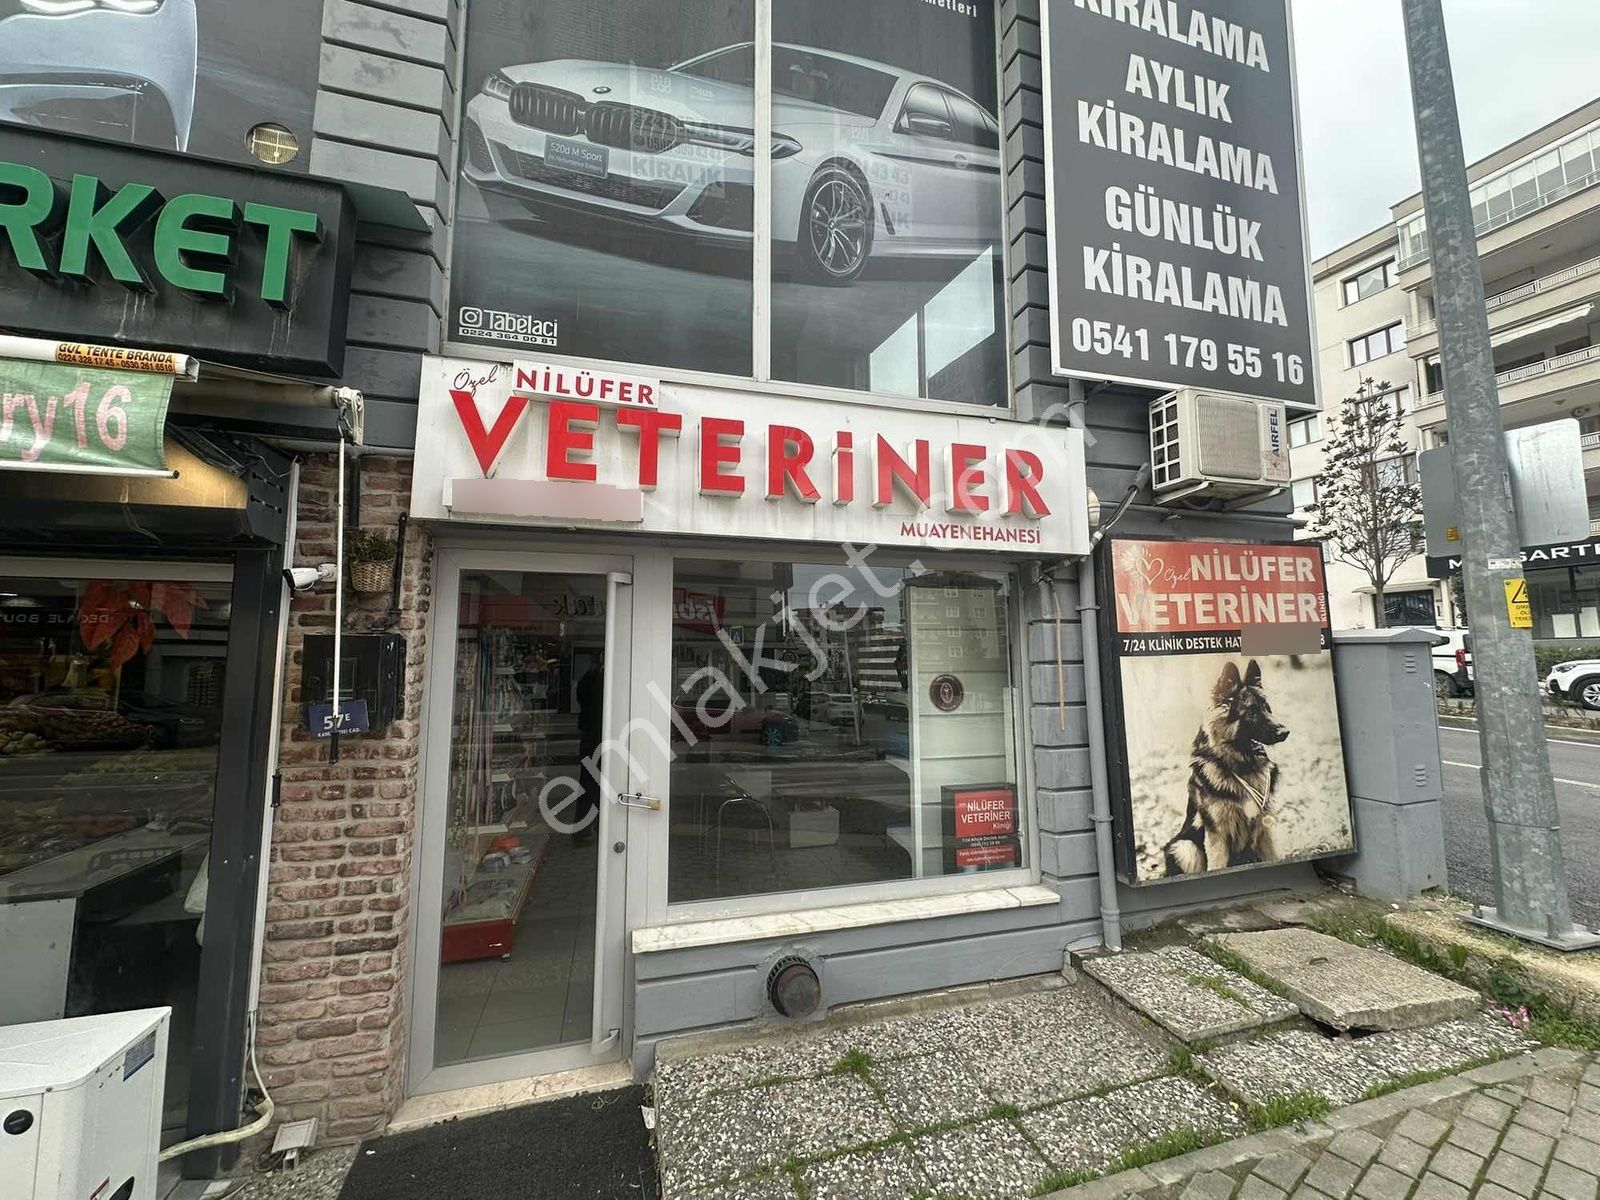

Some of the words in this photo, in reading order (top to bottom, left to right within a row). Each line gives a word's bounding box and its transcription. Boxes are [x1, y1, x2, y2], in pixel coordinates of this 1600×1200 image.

[1125, 53, 1232, 124] AYLIK
[572, 147, 579, 156] M
[1077, 99, 1279, 195] KİRALAMA
[1104, 184, 1264, 262] GÜNLÜK
[1083, 242, 1288, 327] KİRALAMA
[462, 329, 493, 338] 0224
[57, 353, 76, 363] 0224
[86, 345, 123, 359] TENTE
[126, 350, 173, 364] BRANDA
[1072, 317, 1149, 361] 0541
[1164, 333, 1218, 372] 179
[1227, 343, 1262, 378] 55
[1272, 351, 1303, 385] 16
[453, 364, 499, 397] Özel
[516, 366, 654, 405] NİLÜFER
[1269, 408, 1281, 458] AIRFEL
[900, 522, 1041, 544] MUAYENEHANESİ
[1190, 549, 1315, 583] NİLÜFER
[1118, 585, 1321, 626] VETERİNER
[1123, 639, 1146, 652] 7/24
[1148, 636, 1184, 651] KLİNİK
[1186, 636, 1222, 650] DESTEK
[961, 810, 1011, 824] VETERİNER
[967, 799, 1005, 812] NİLÜFER
